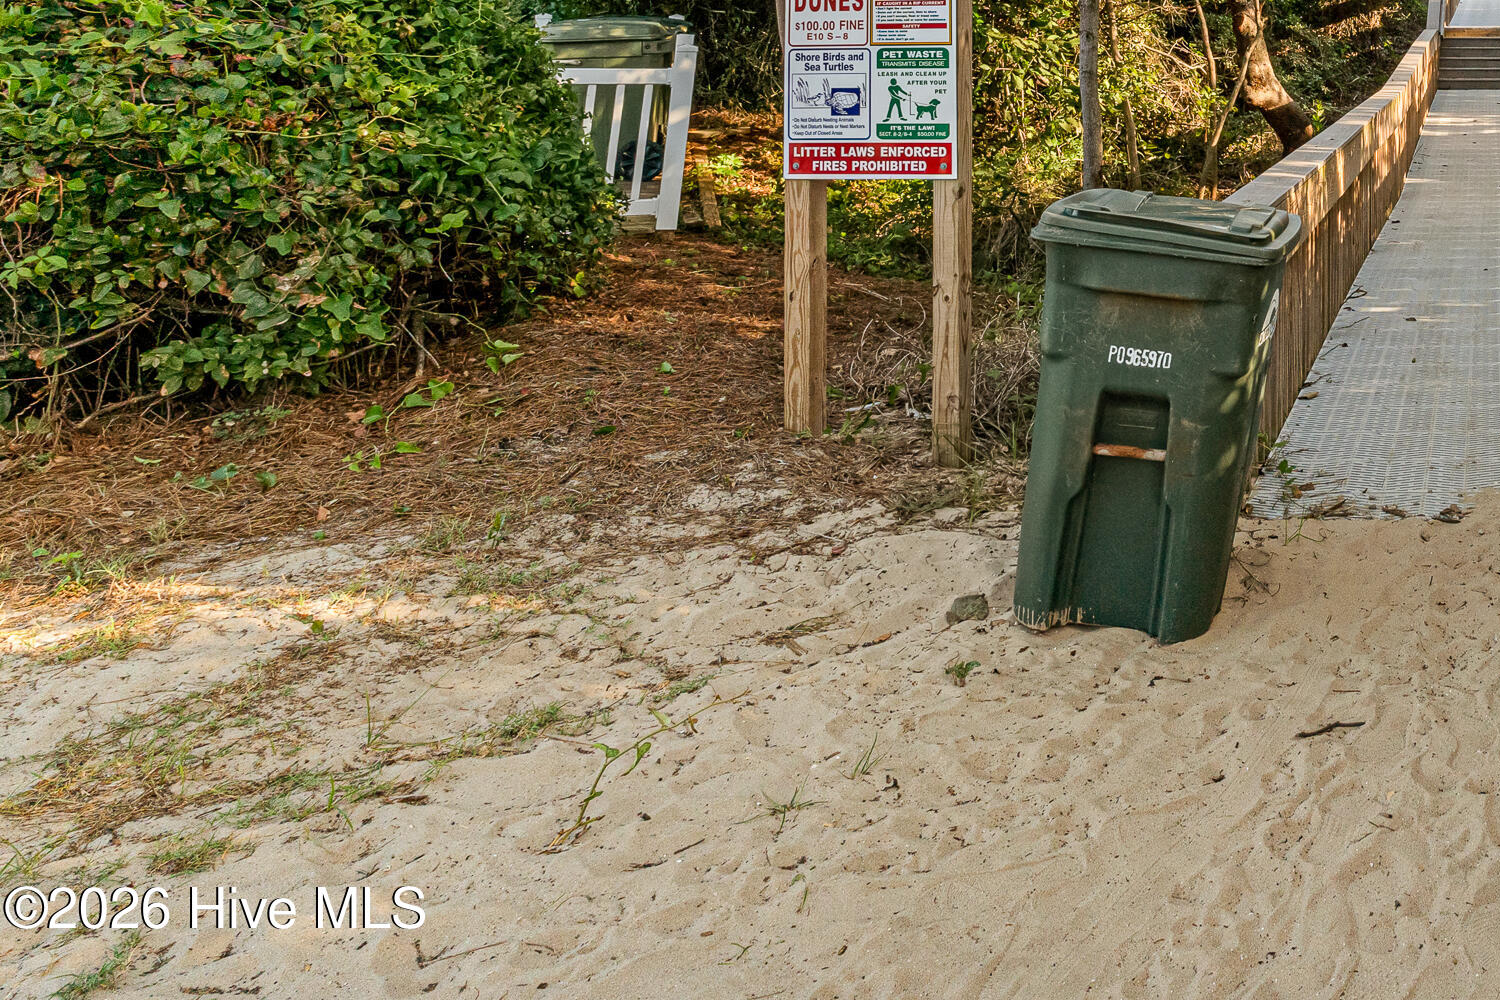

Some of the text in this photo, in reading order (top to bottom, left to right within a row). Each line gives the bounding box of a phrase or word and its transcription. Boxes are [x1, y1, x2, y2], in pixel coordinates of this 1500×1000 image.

[795, 20, 864, 31] $100.00 FINE
[807, 33, 824, 41] E10
[795, 52, 864, 61] Shore Birds and
[804, 62, 854, 71] Sea Turtles
[793, 147, 947, 157] LITTER LAWS ENFORCED
[812, 160, 927, 171] FIRES PROHIBITED
